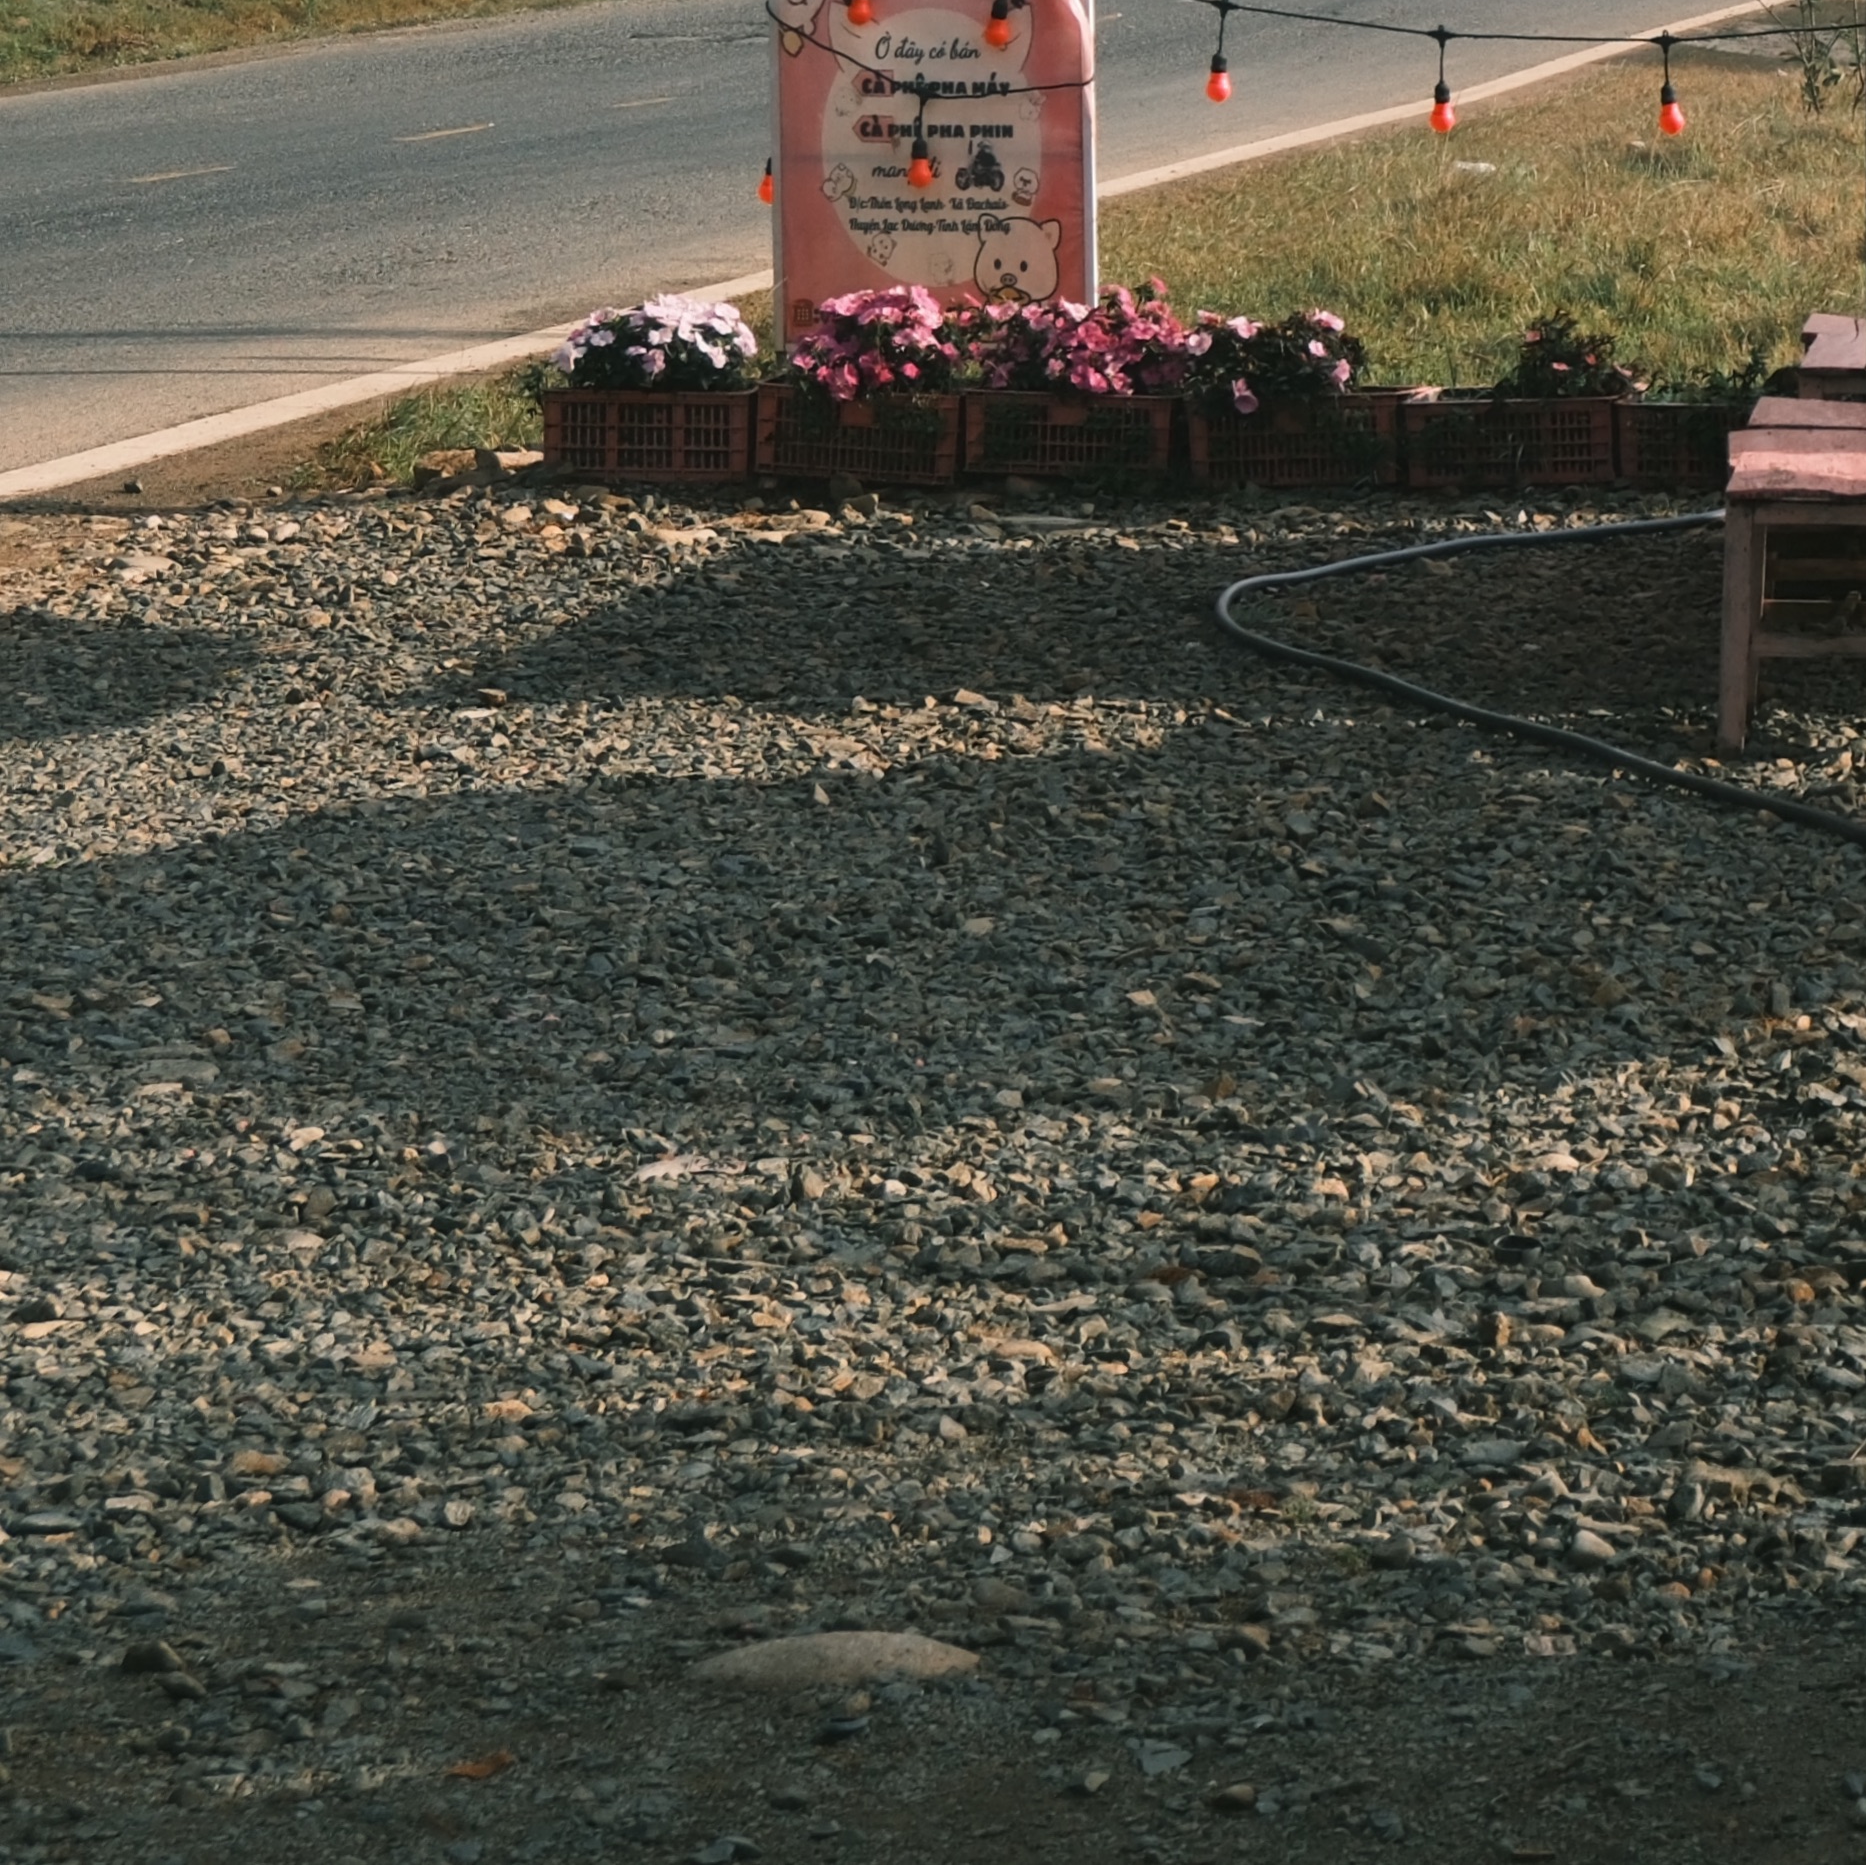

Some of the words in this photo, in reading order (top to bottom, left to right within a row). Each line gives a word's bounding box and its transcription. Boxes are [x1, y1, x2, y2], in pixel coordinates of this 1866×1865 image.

[894, 36, 925, 65] đây
[929, 41, 946, 59] có
[949, 37, 981, 60] bán
[928, 81, 967, 95] PHA
[972, 72, 1010, 97] MÁY
[860, 114, 883, 137] CÀ
[927, 124, 965, 138] PHA
[970, 124, 1013, 138] PHIN
[872, 164, 914, 186] man
